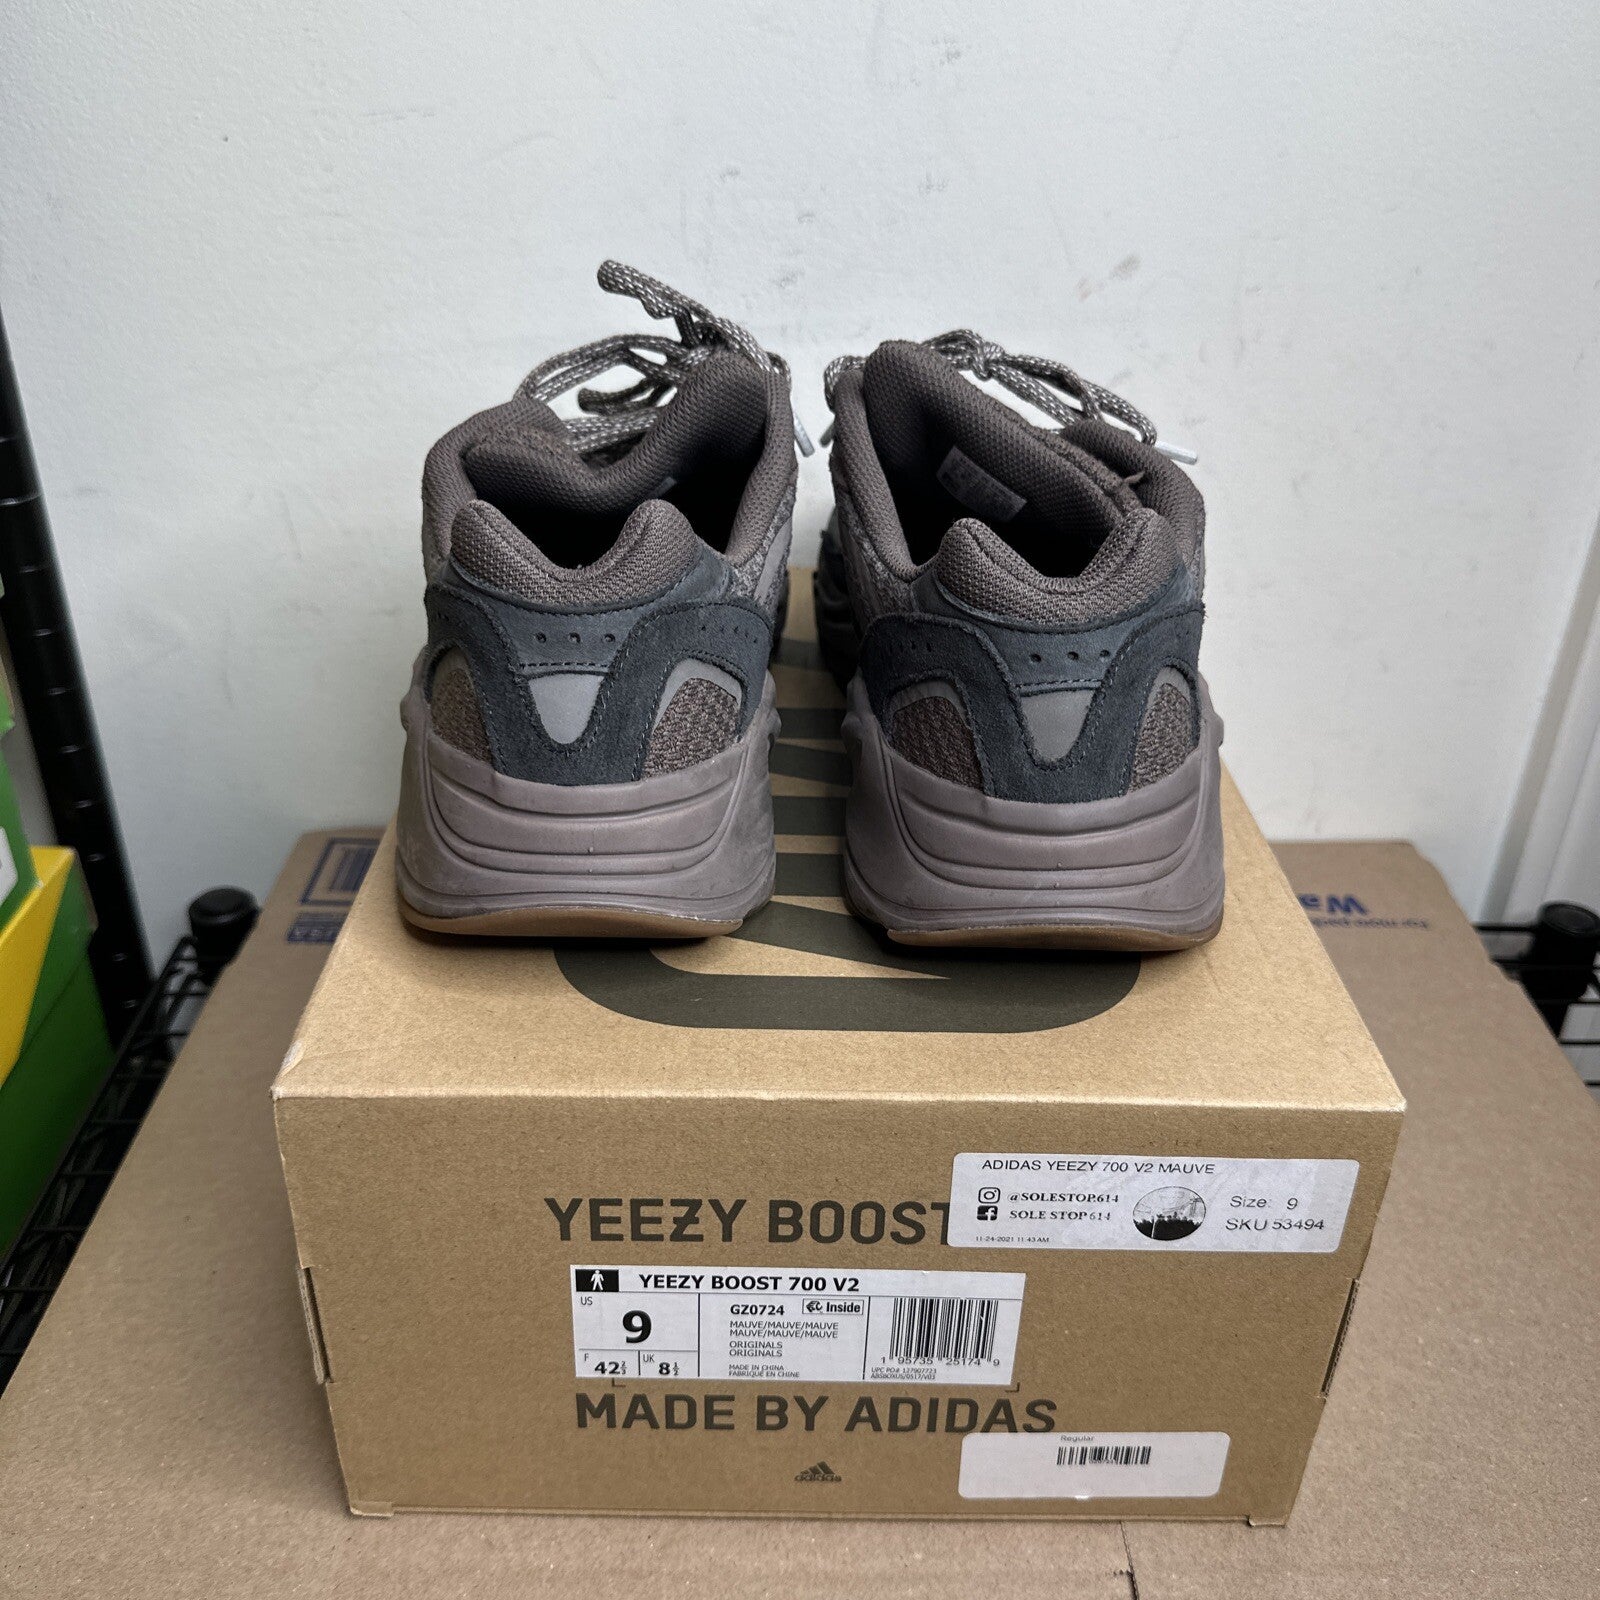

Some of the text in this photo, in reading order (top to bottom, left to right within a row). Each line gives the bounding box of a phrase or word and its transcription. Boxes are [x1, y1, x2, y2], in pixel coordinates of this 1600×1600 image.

[982, 1160, 1215, 1174] ADIDAS YEEZY 700 V2 MAUVE
[1286, 1197, 1299, 1210] 9
[1009, 1210, 1111, 1221] SOLE STOP 614
[1225, 1218, 1325, 1231] SKU 53494
[639, 1274, 860, 1292] YEEZY BOOST 700 V2
[580, 1296, 593, 1306] US
[730, 1304, 785, 1315] GZ0724
[826, 1301, 861, 1313] Inside
[622, 1310, 652, 1343] 9
[729, 1321, 839, 1330] MAUVE/MAUVE/MAUVE
[729, 1329, 838, 1339] MAUVE/MAUVE/MAUVE
[729, 1341, 783, 1349] ORIGINALS
[584, 1353, 589, 1362] F
[643, 1354, 655, 1362] UK
[729, 1349, 783, 1357] ORIGINALS
[897, 1356, 934, 1365] 95735
[945, 1357, 982, 1366] 25174
[993, 1358, 1000, 1366] 9
[576, 1393, 1058, 1433] MADE BY ADIDAS
